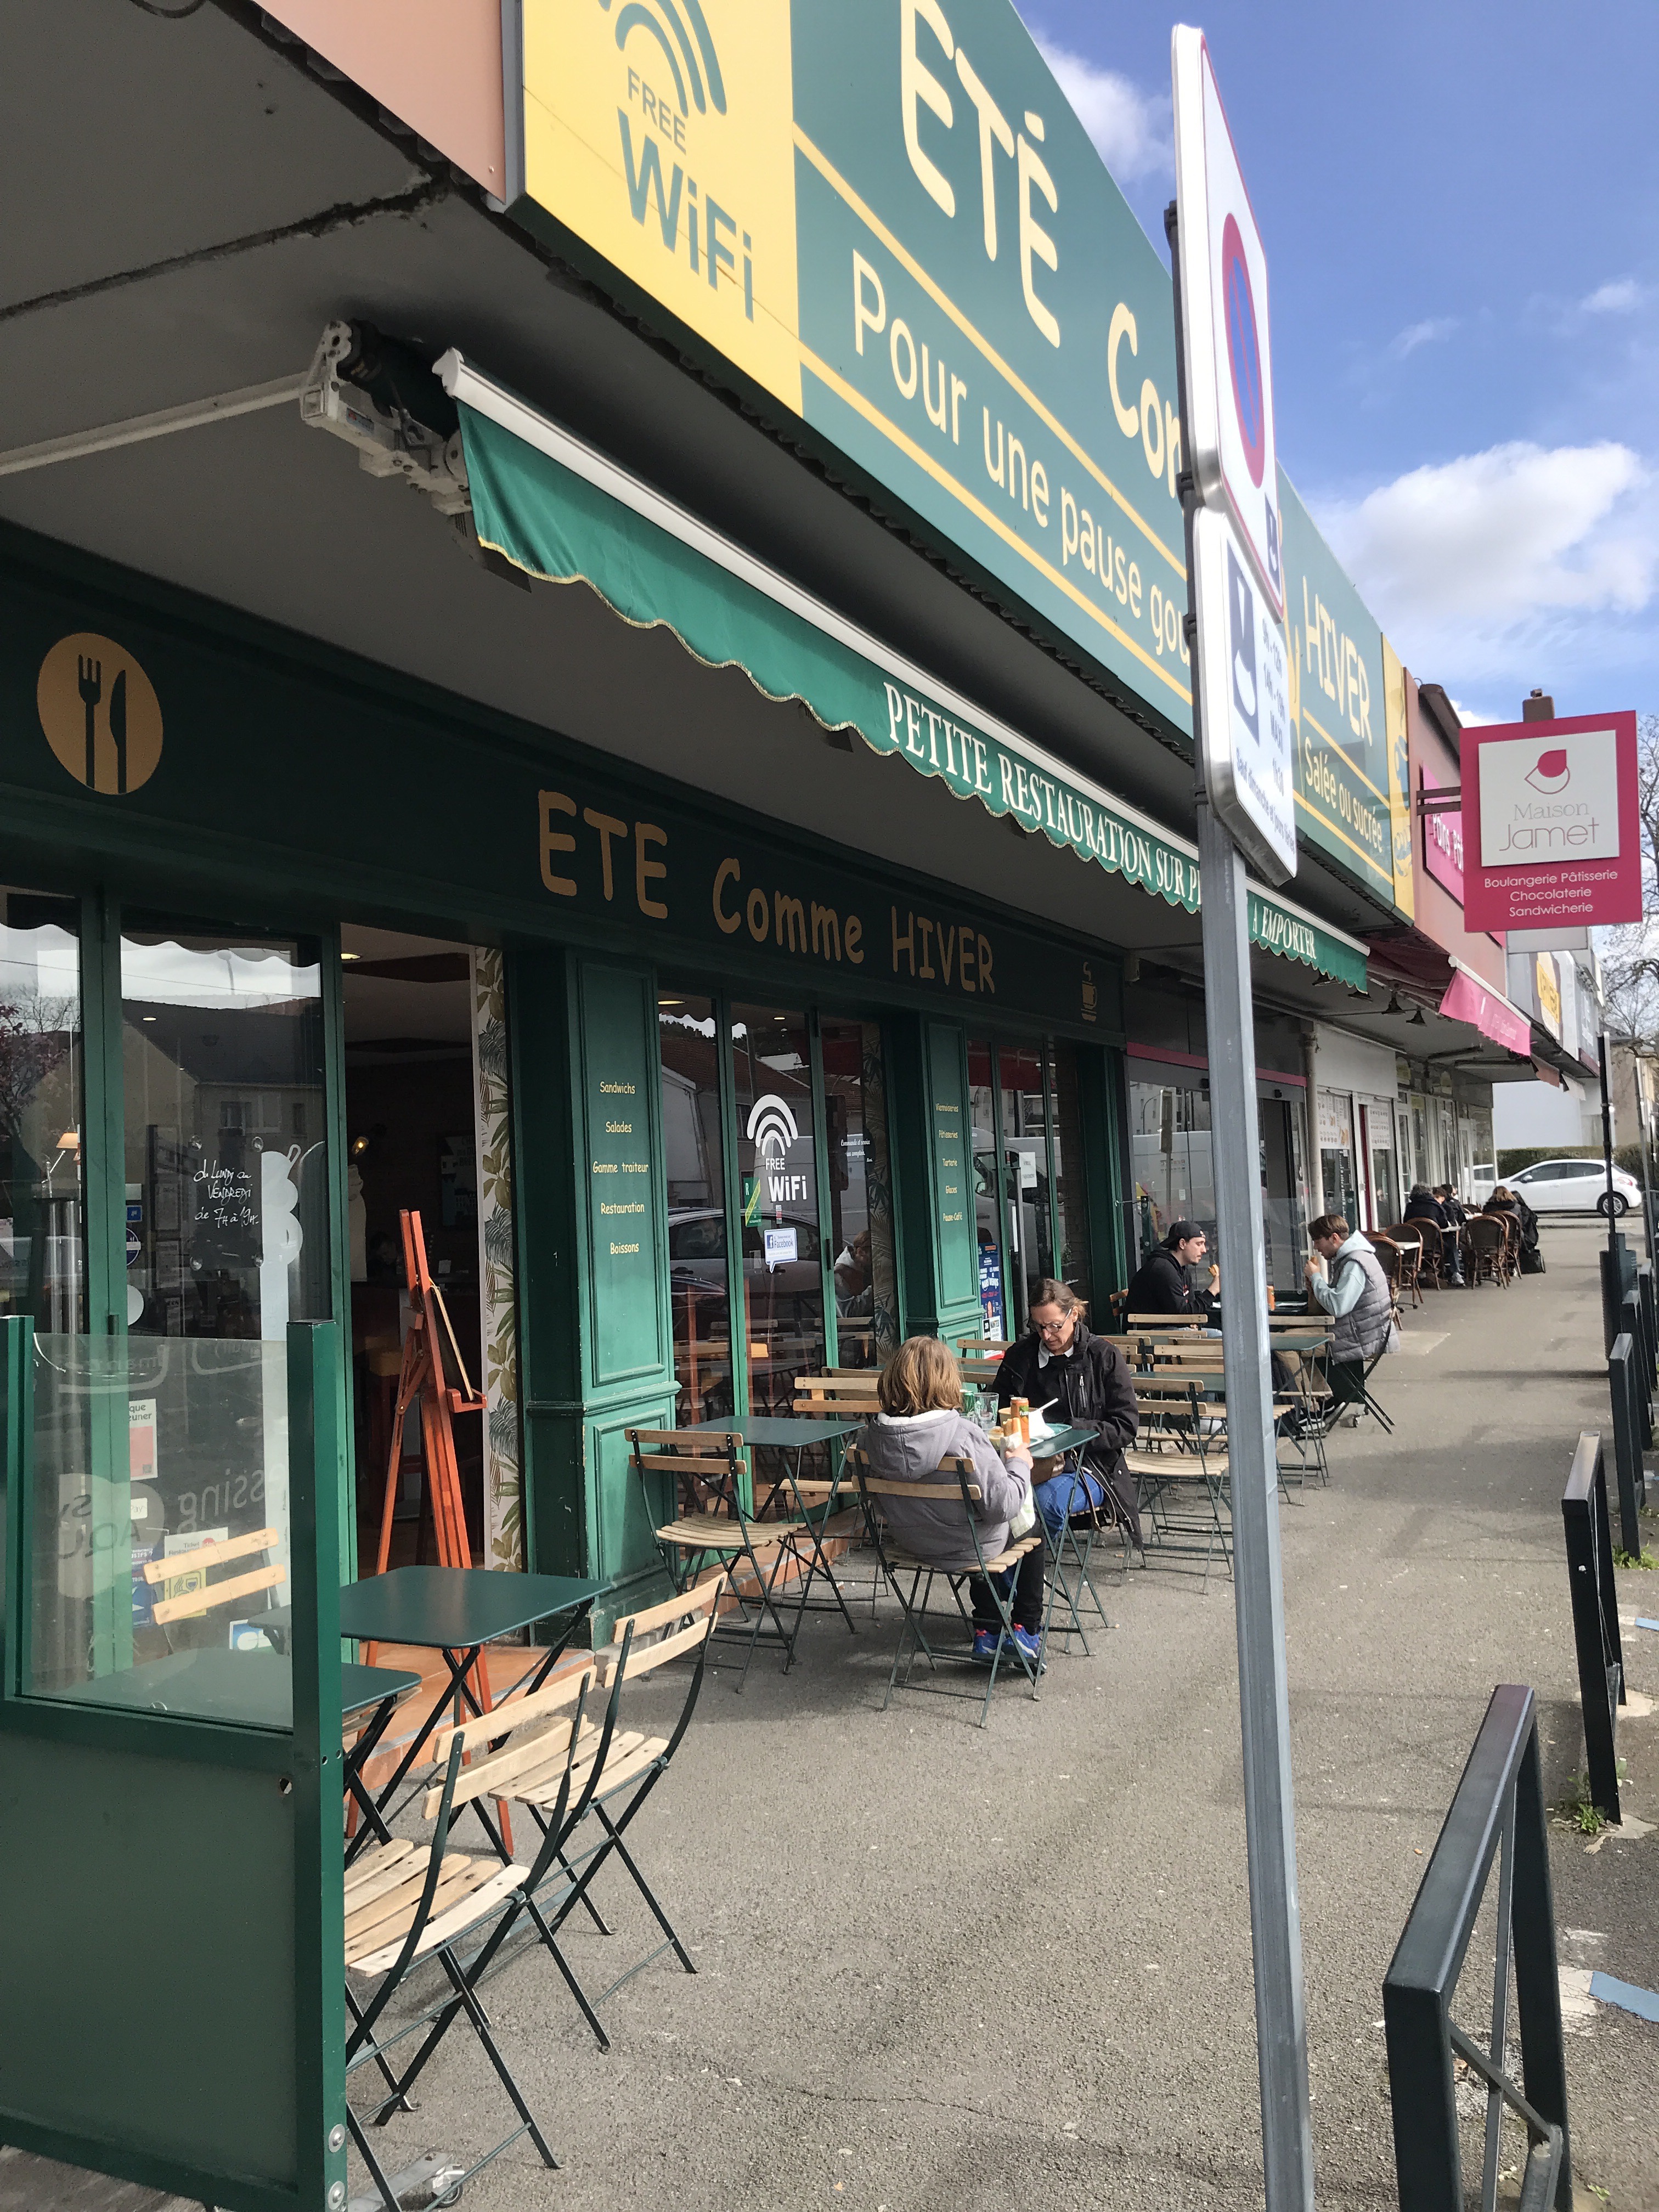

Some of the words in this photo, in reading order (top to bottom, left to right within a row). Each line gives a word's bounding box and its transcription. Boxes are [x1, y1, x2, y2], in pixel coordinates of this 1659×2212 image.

[628, 65, 686, 156] FREE
[617, 106, 753, 323] WiFi
[853, 249, 967, 445] Pour
[983, 406, 1049, 528] une
[1061, 486, 1142, 620] pause
[1303, 575, 1373, 747] HIVER
[884, 682, 991, 794] PETITE
[997, 753, 1152, 881] RESTAURATION
[1156, 848, 1186, 898] SUR
[1305, 736, 1337, 811] Salée
[1339, 781, 1352, 824] ou
[1353, 799, 1383, 853] sucrée
[1514, 802, 1590, 821] Maison
[1499, 817, 1600, 851] Jamet
[1484, 873, 1558, 888] Boulangerie
[1561, 870, 1618, 883] Pâtisserie
[539, 789, 668, 919] ETE
[713, 857, 865, 964] Comme
[891, 906, 995, 995] HIVER
[1510, 887, 1592, 902] Chocolaterie
[1509, 902, 1593, 917] Sandwicherie
[1261, 906, 1317, 960] EMPORTER
[600, 1081, 635, 1094] Sandwichs
[605, 1120, 632, 1133] Salades
[193, 1159, 208, 1182] du
[592, 1161, 618, 1173] Gamme
[622, 1161, 649, 1173] traiteur
[765, 1158, 786, 1170] FREE
[768, 1176, 807, 1202] WiFi
[195, 1206, 210, 1220] de
[600, 1201, 645, 1215] Restauration
[610, 1242, 639, 1255] Boissons
[774, 1238, 794, 1249] Facebook
